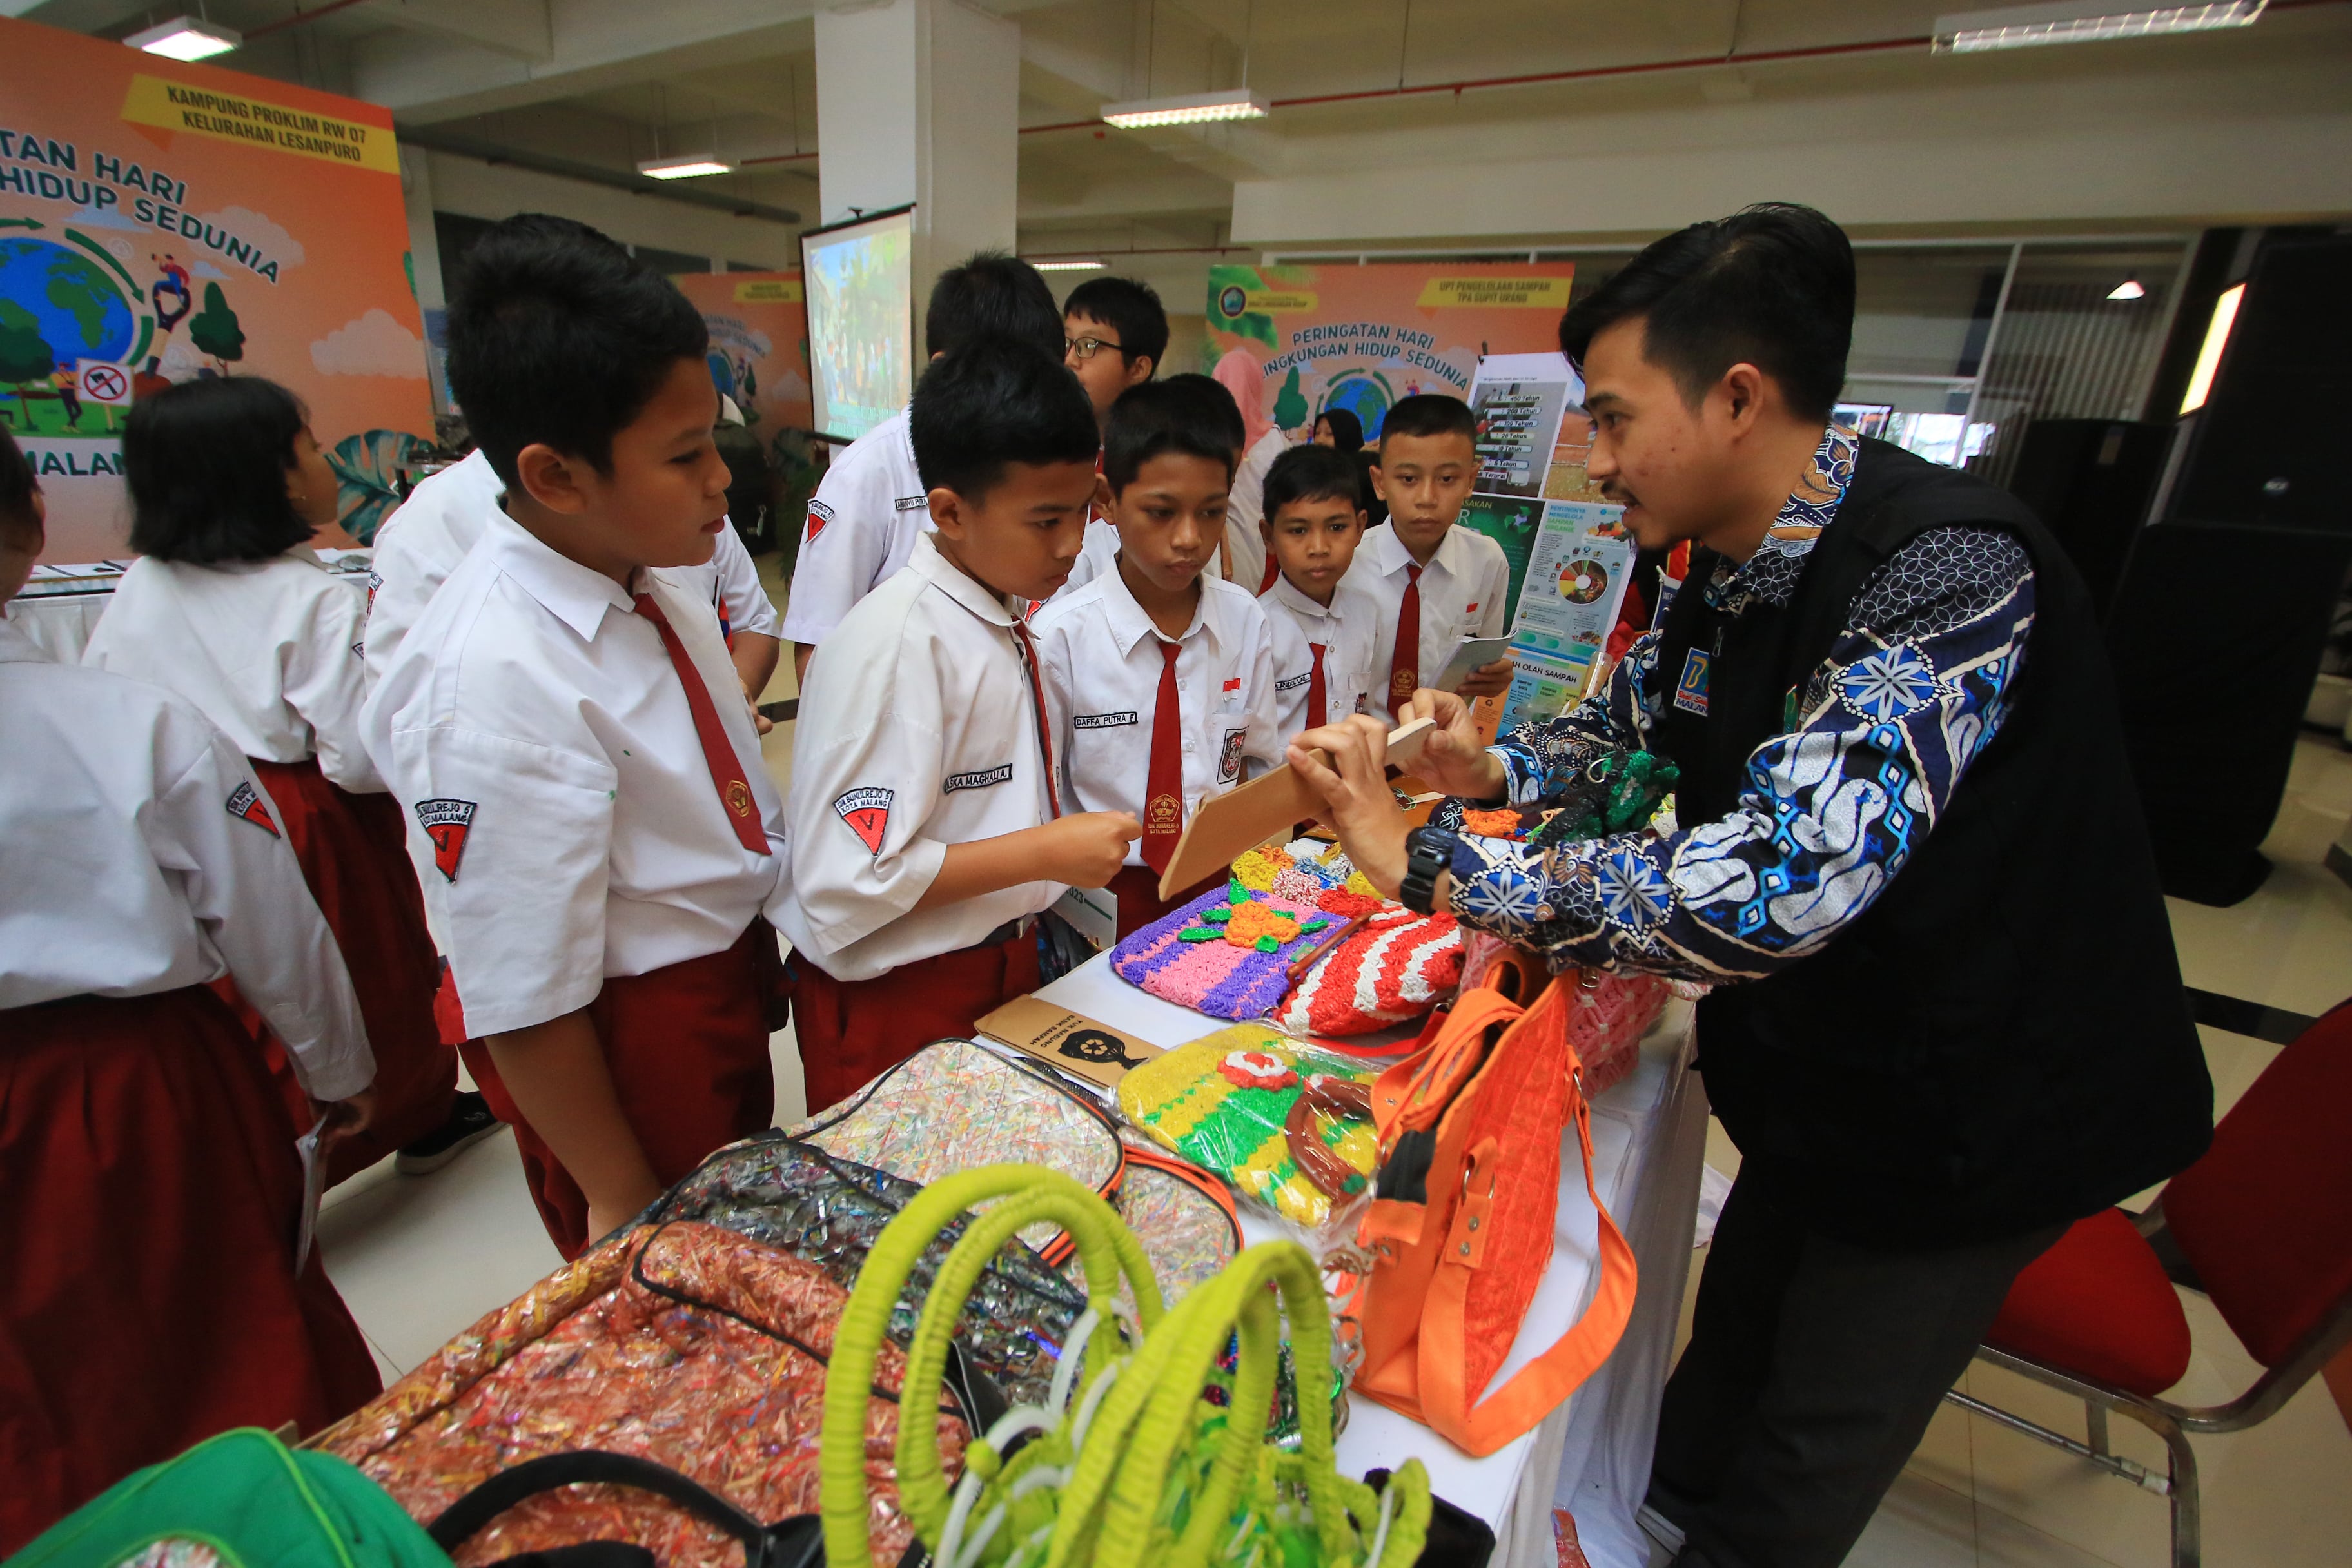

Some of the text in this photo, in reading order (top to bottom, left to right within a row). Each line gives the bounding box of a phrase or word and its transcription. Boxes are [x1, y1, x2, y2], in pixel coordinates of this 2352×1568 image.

[166, 86, 366, 144] KAMPUNG PROKLIM RW 07
[182, 110, 362, 161] KELURAHAN LESANPURO
[94, 153, 187, 206] HARI
[0, 165, 280, 284] HIDUP SEDUNIA
[1293, 322, 1435, 351] PERINGATAN HARI
[1263, 342, 1469, 391] INGKUNGAN HIDUP SEDUNIA
[1522, 663, 1544, 674] OLAH
[1544, 669, 1577, 683] SAMPAH
[1676, 698, 1708, 713] MALAN
[1076, 718, 1101, 726] DAFFA
[1103, 714, 1126, 725] PUTRA
[946, 777, 963, 790] ASKA
[966, 770, 999, 785] MAGHALI
[237, 798, 251, 813] KOTA
[840, 799, 888, 813] KOTA MALANG
[846, 790, 883, 803] BUNULREJO
[885, 792, 890, 800] 5
[431, 812, 467, 823] MALANG
[464, 805, 471, 814] 5
[857, 812, 874, 831] V
[1029, 1014, 1075, 1045] BANK SAMPAH
[1040, 1019, 1084, 1048] YUK NABUNG
